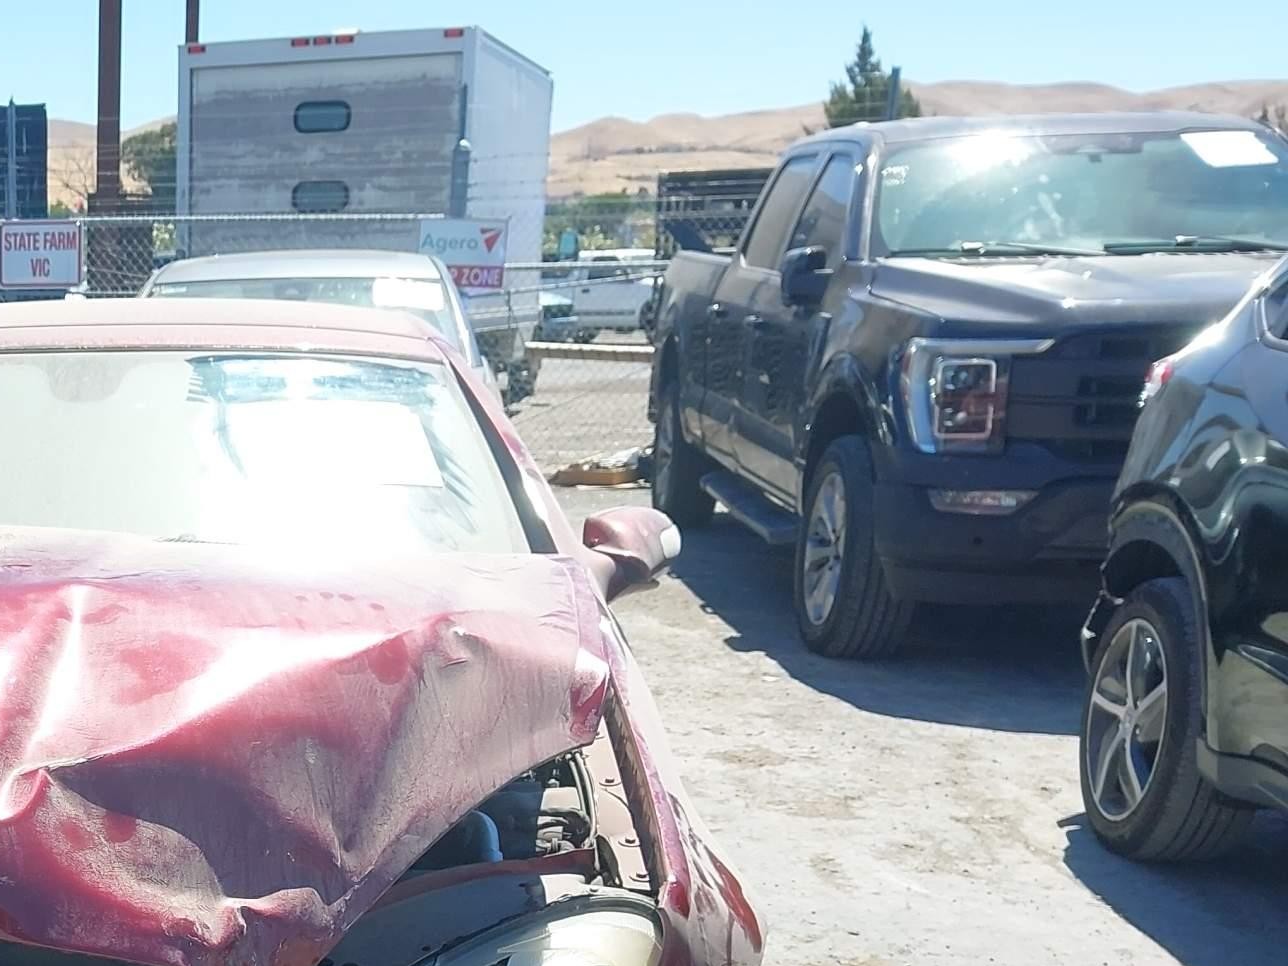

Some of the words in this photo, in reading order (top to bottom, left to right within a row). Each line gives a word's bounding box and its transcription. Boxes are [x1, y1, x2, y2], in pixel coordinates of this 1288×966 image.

[4, 231, 40, 252] STATE
[43, 231, 77, 251] FARM
[421, 233, 479, 255] Agero
[30, 257, 50, 278] VIC
[460, 268, 501, 285] ZONE
